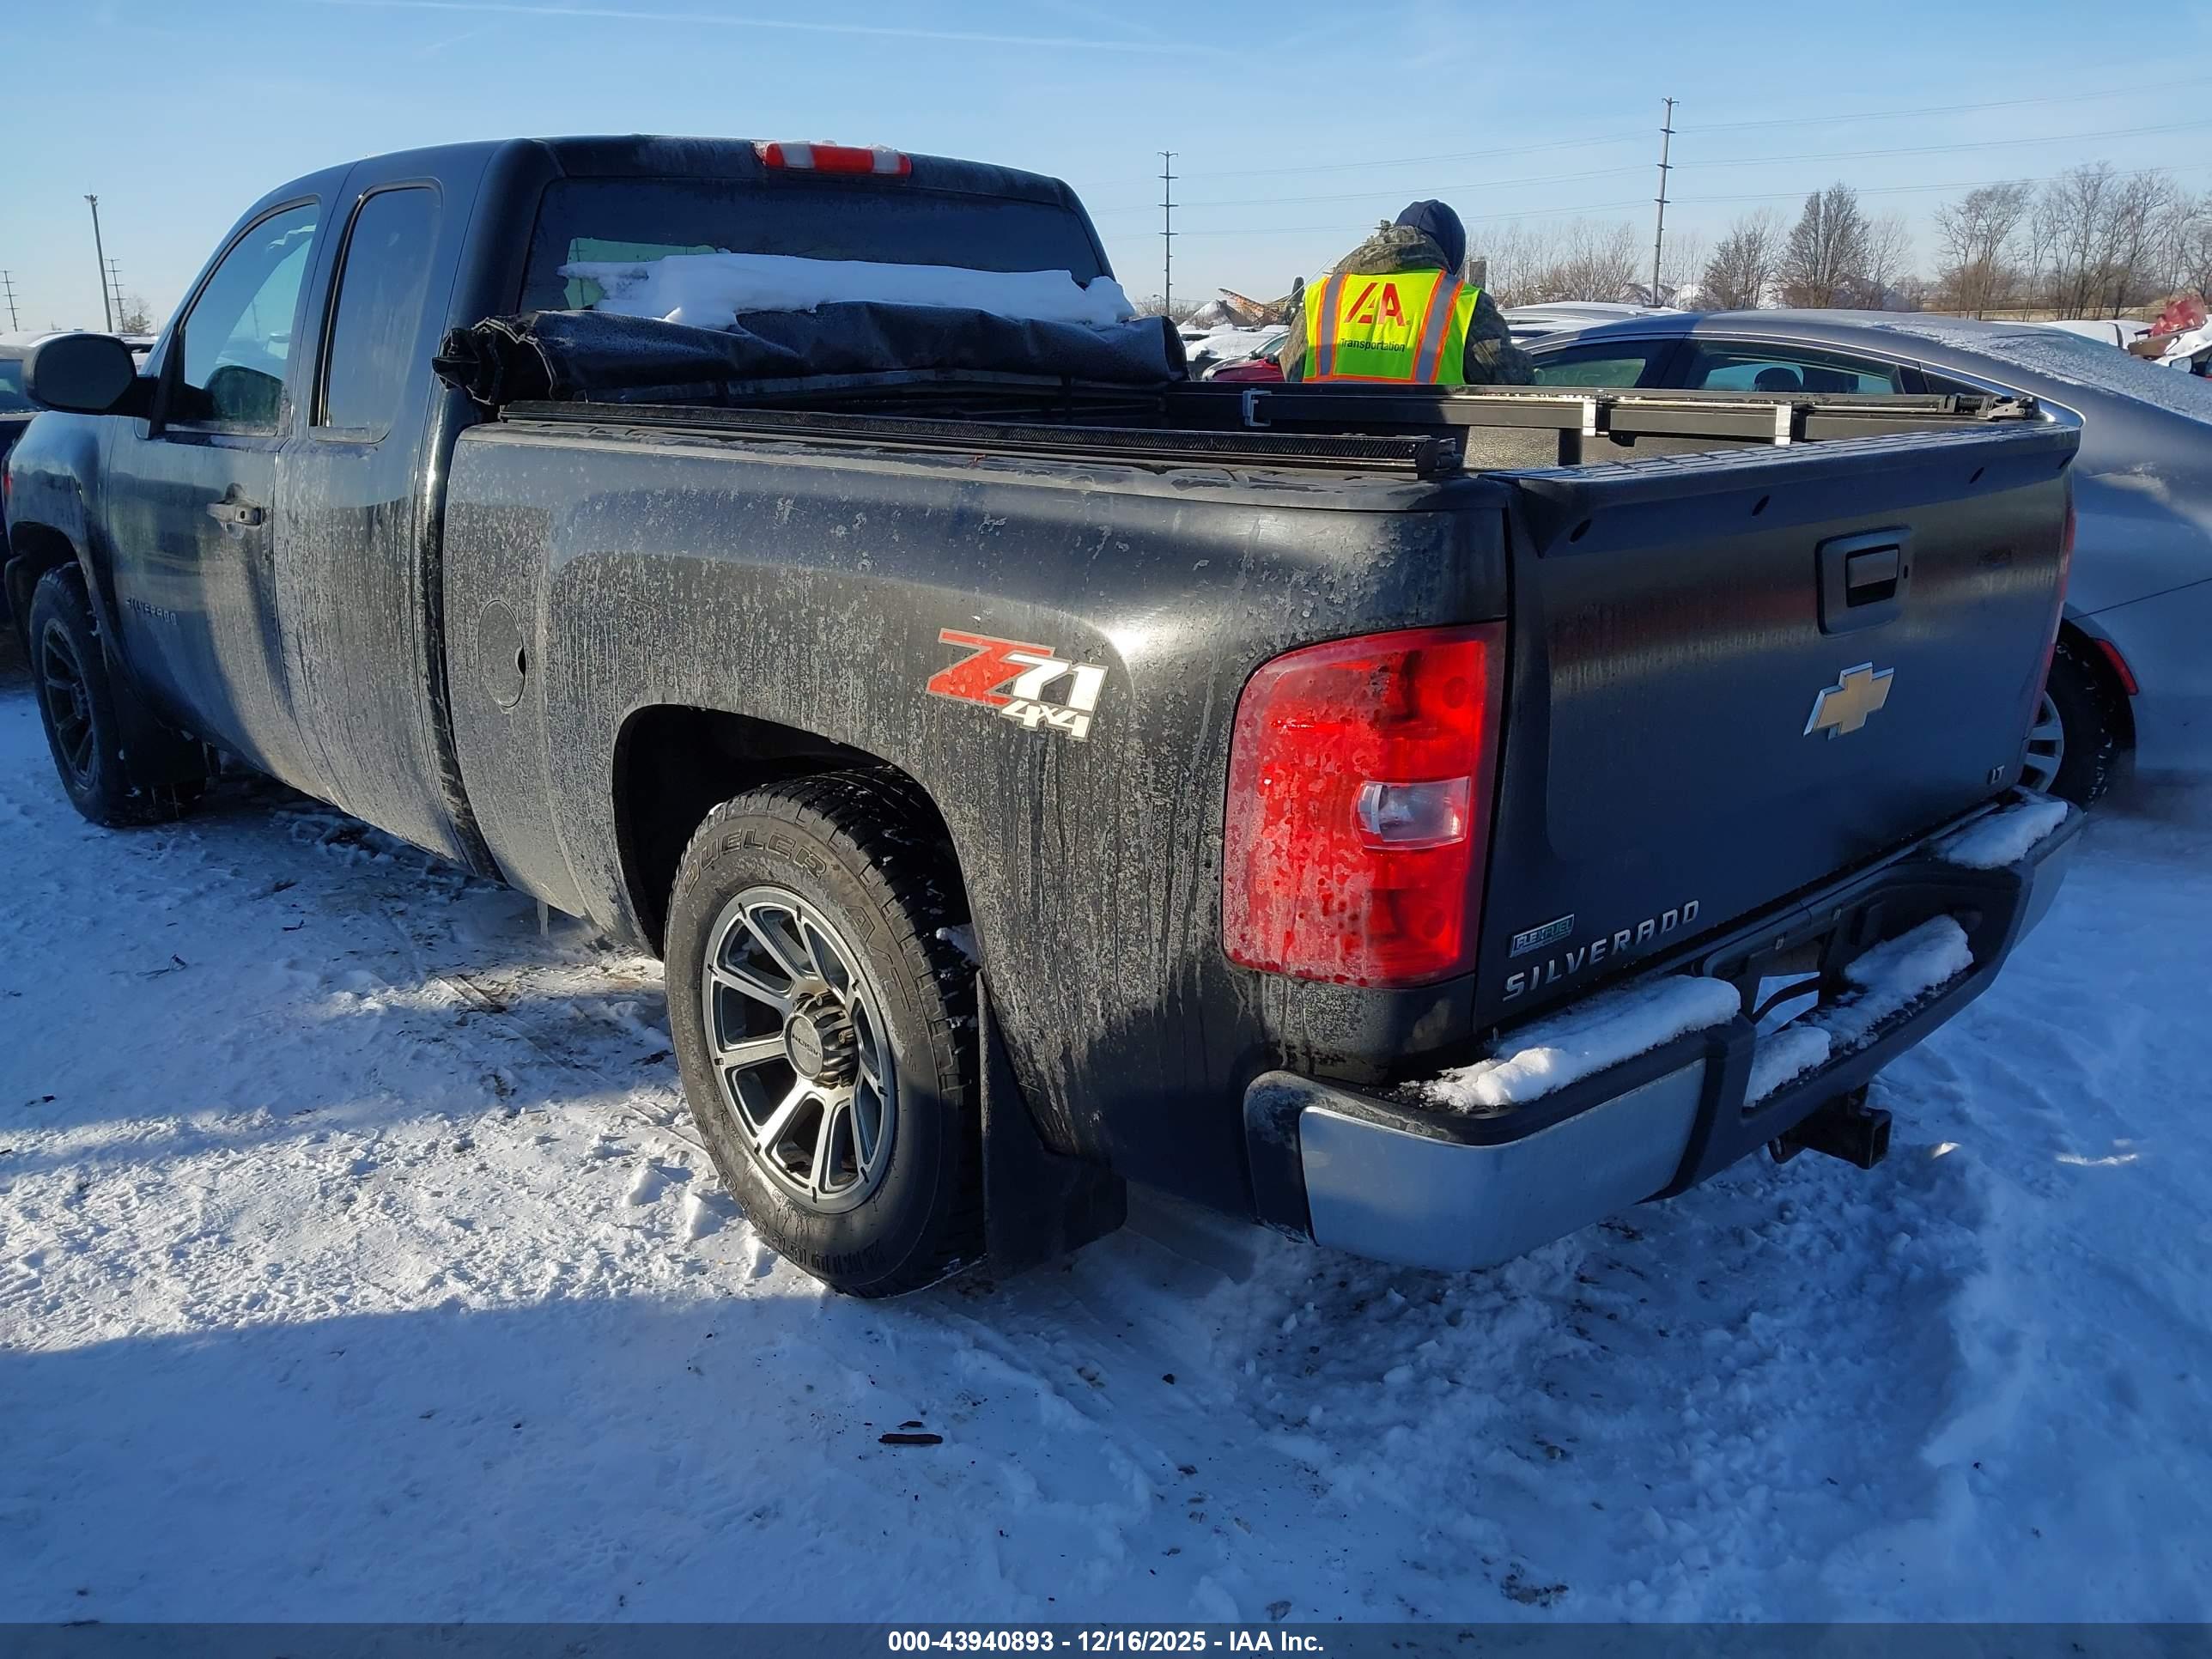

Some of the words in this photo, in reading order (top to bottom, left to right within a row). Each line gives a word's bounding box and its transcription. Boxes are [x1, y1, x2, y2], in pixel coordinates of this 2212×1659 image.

[1340, 337, 1406, 353] Transportation
[927, 627, 1109, 712] Z71
[1502, 899, 1700, 1003] SILVERADO
